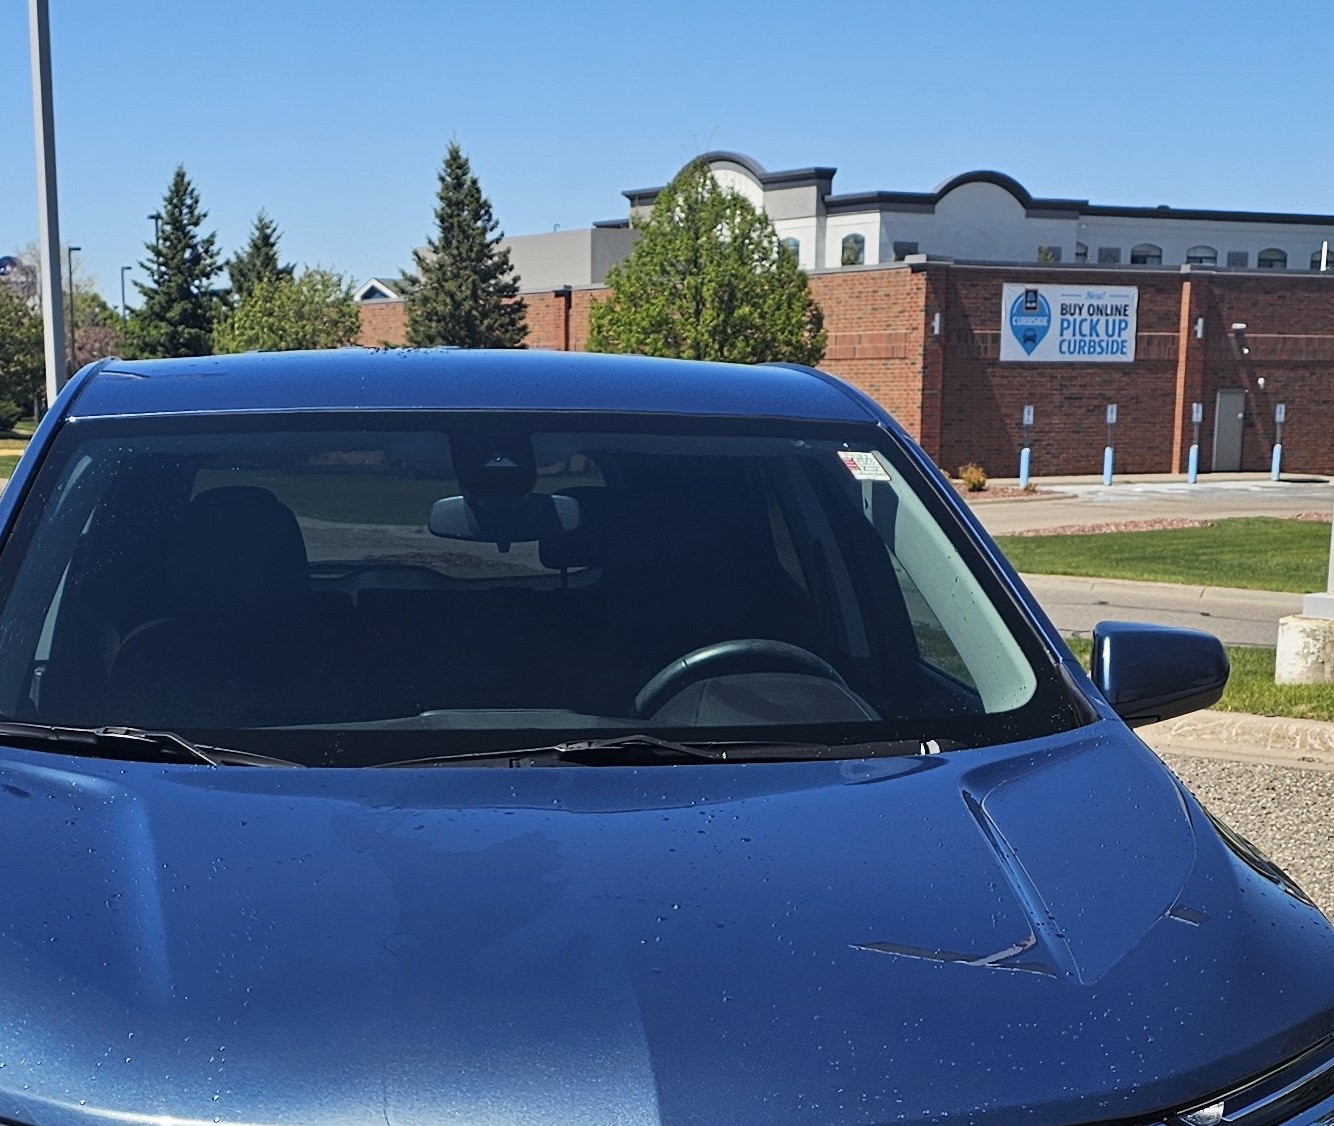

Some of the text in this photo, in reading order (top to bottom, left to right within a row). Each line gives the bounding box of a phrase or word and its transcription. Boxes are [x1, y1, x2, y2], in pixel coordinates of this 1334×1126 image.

[1060, 303, 1129, 317] BUY ONLINE
[1059, 318, 1129, 338] PICK UP
[1059, 339, 1128, 355] CURBSIDE
